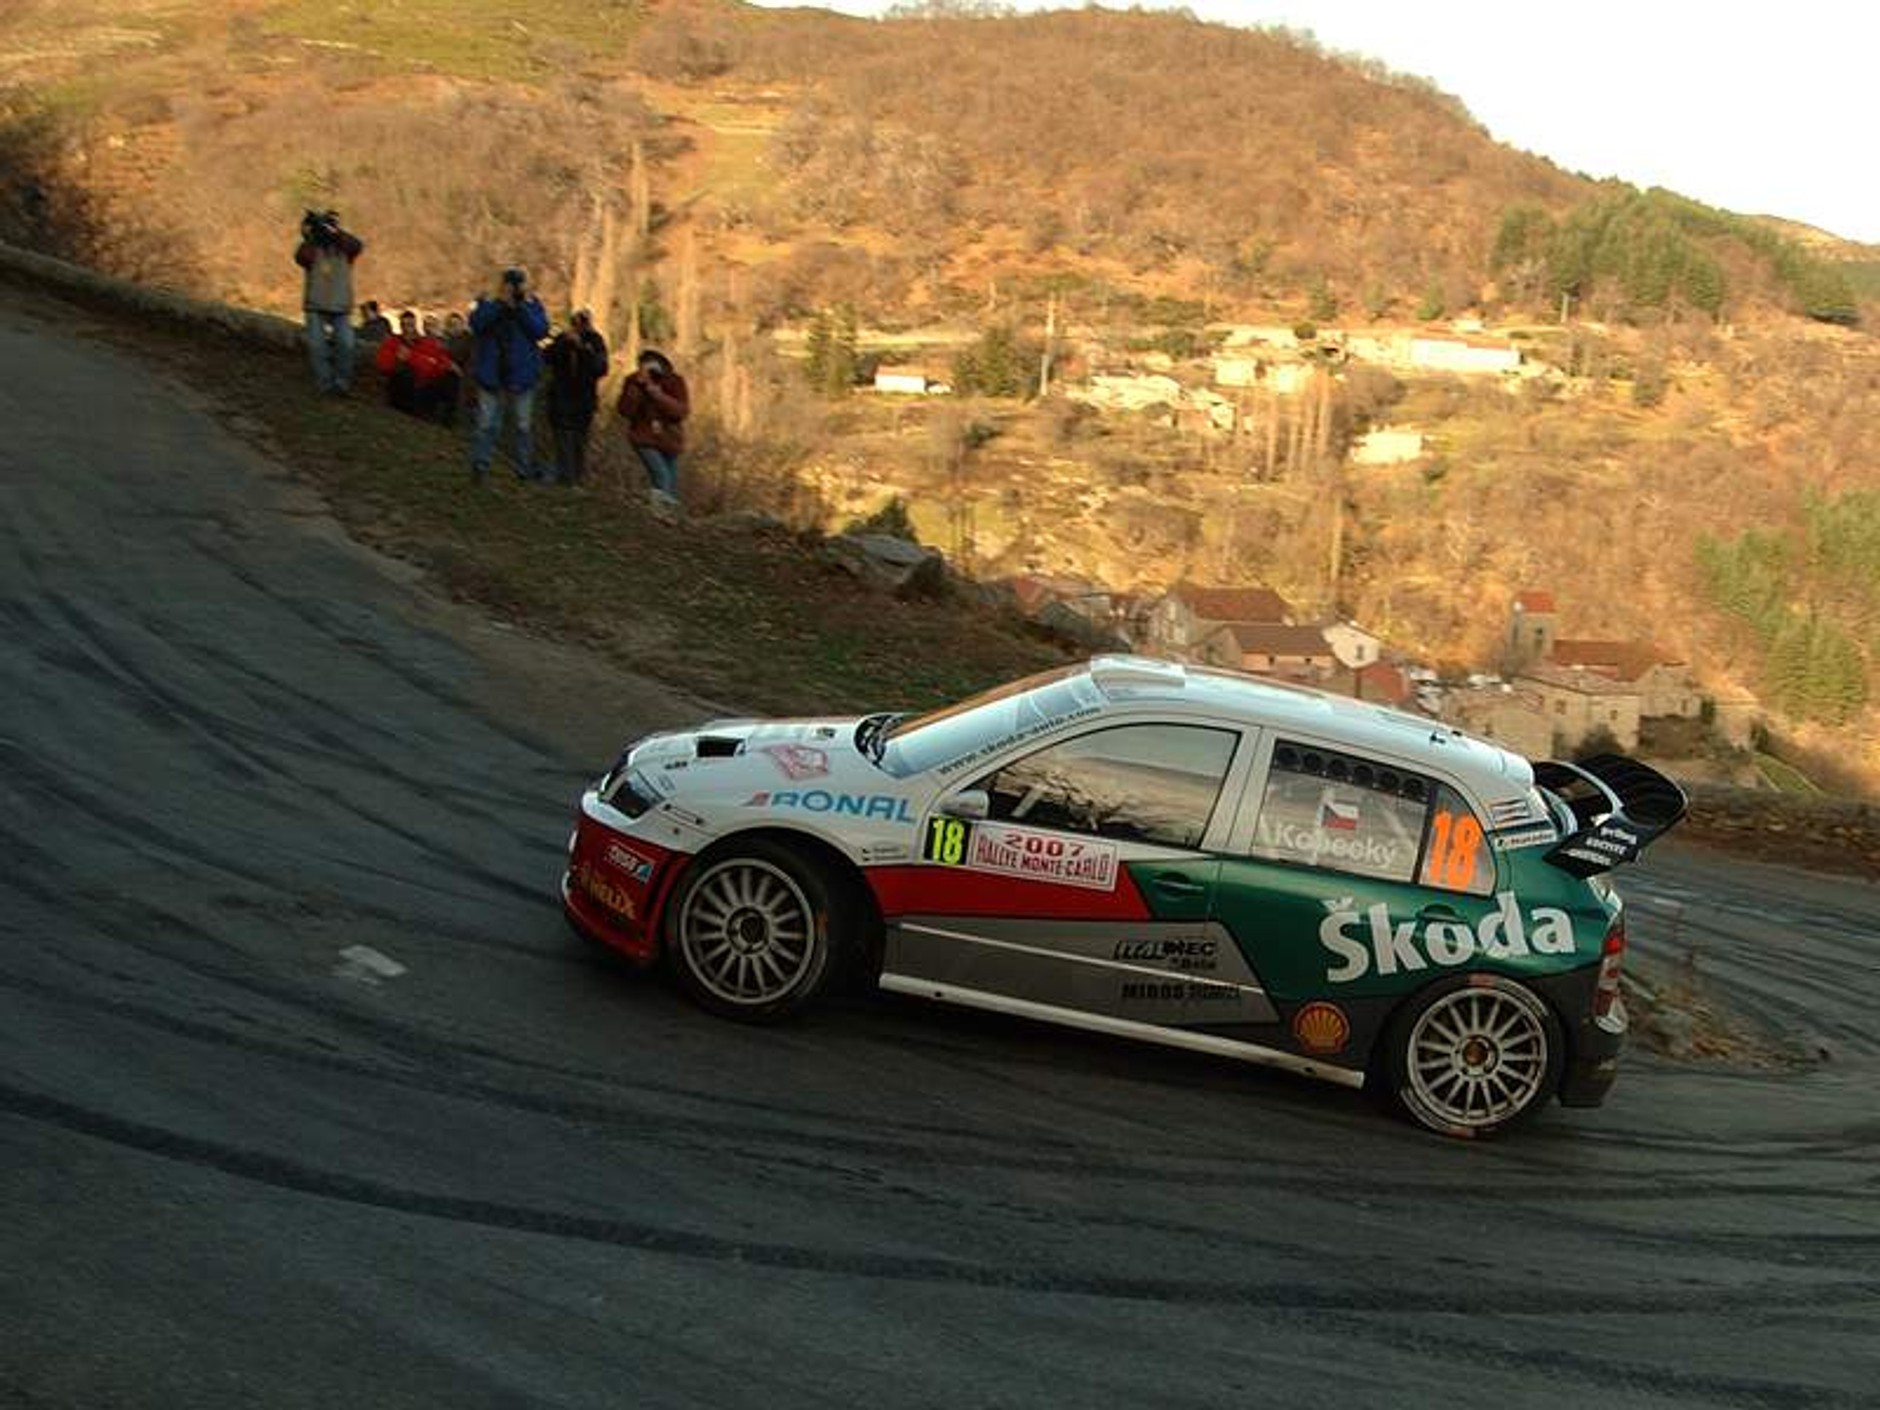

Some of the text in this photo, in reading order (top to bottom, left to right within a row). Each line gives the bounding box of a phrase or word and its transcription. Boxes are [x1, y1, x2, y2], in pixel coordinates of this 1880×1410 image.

[771, 790, 917, 823] RONAL
[933, 819, 965, 865] 18
[976, 835, 1017, 868] RALLYE
[1005, 833, 1085, 857] 2007
[1428, 808, 1482, 891] 18
[1317, 891, 1576, 982] Škoda
